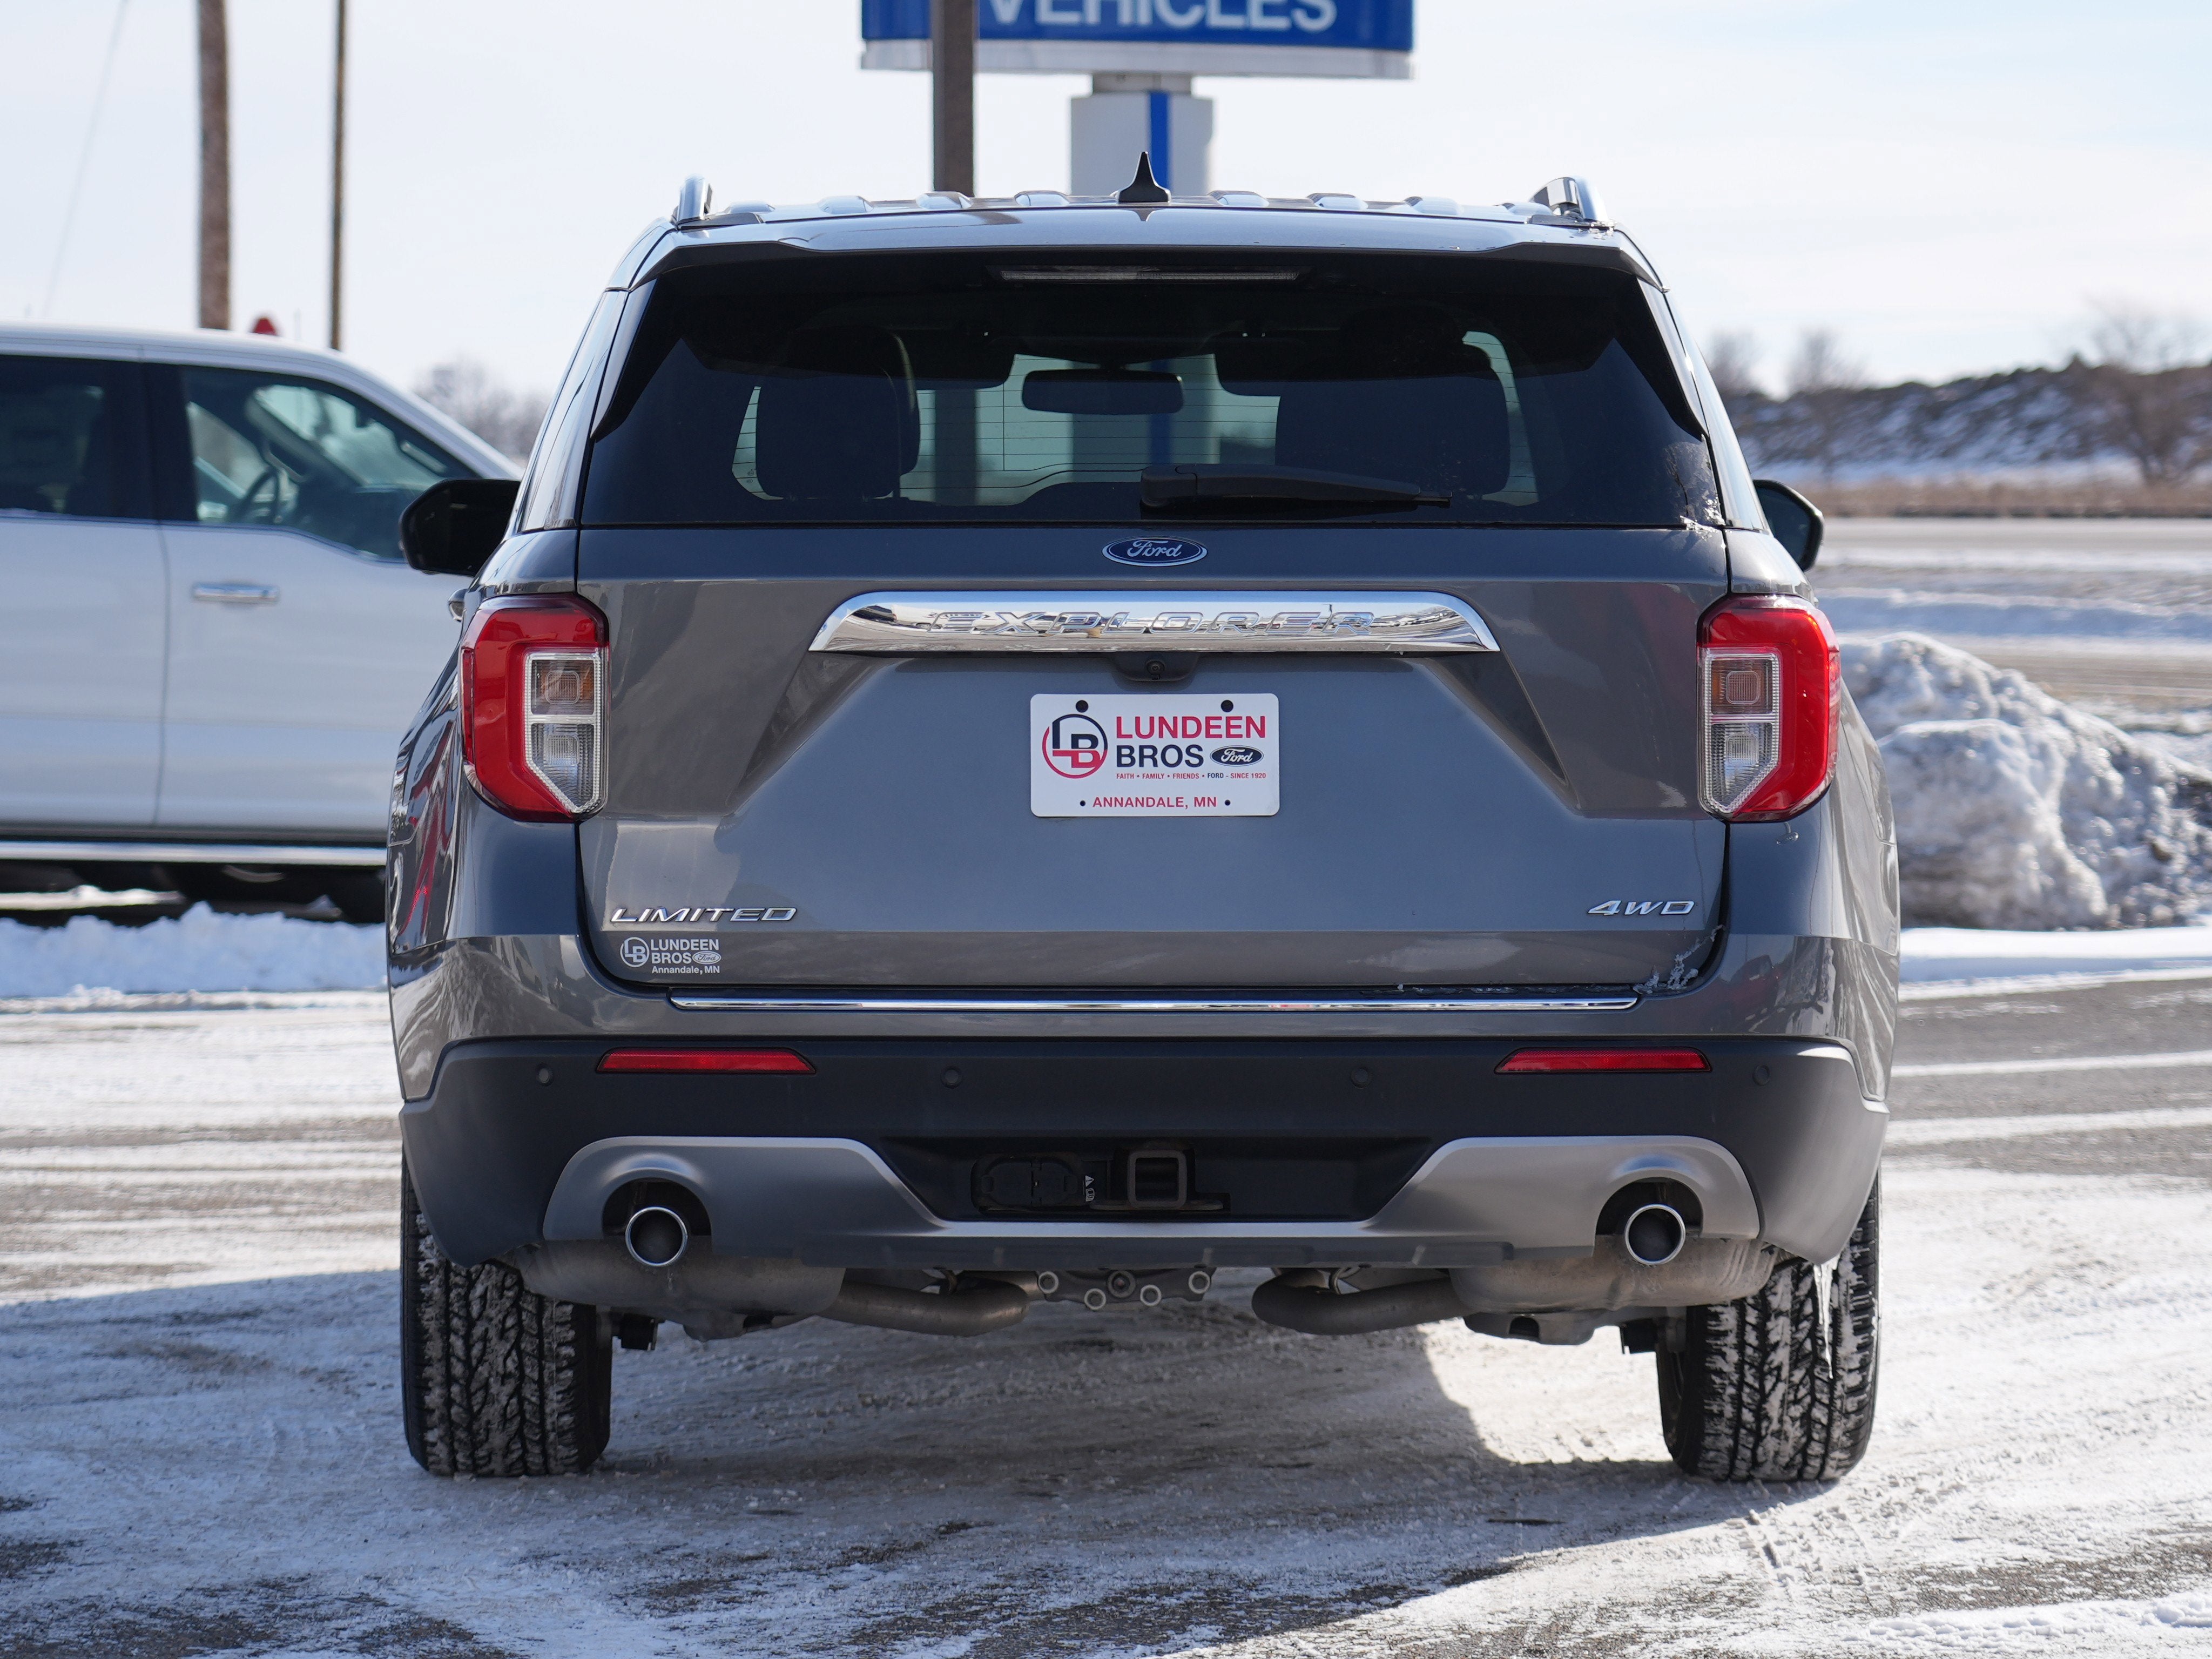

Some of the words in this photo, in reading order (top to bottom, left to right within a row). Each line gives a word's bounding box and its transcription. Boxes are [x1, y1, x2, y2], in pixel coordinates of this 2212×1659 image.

[926, 611, 1375, 634] EXPLORER
[1116, 716, 1266, 739] LUNDEEN
[1116, 744, 1204, 767] BROS
[1092, 797, 1189, 809] ANNANDALE,
[1193, 797, 1217, 807] MN
[611, 907, 798, 922] LIMITED
[1588, 900, 1695, 916] 4WD
[650, 939, 719, 951] LUNDEEN
[651, 952, 692, 964] BROS
[651, 966, 703, 975] Annandale,
[704, 966, 720, 974] MN
